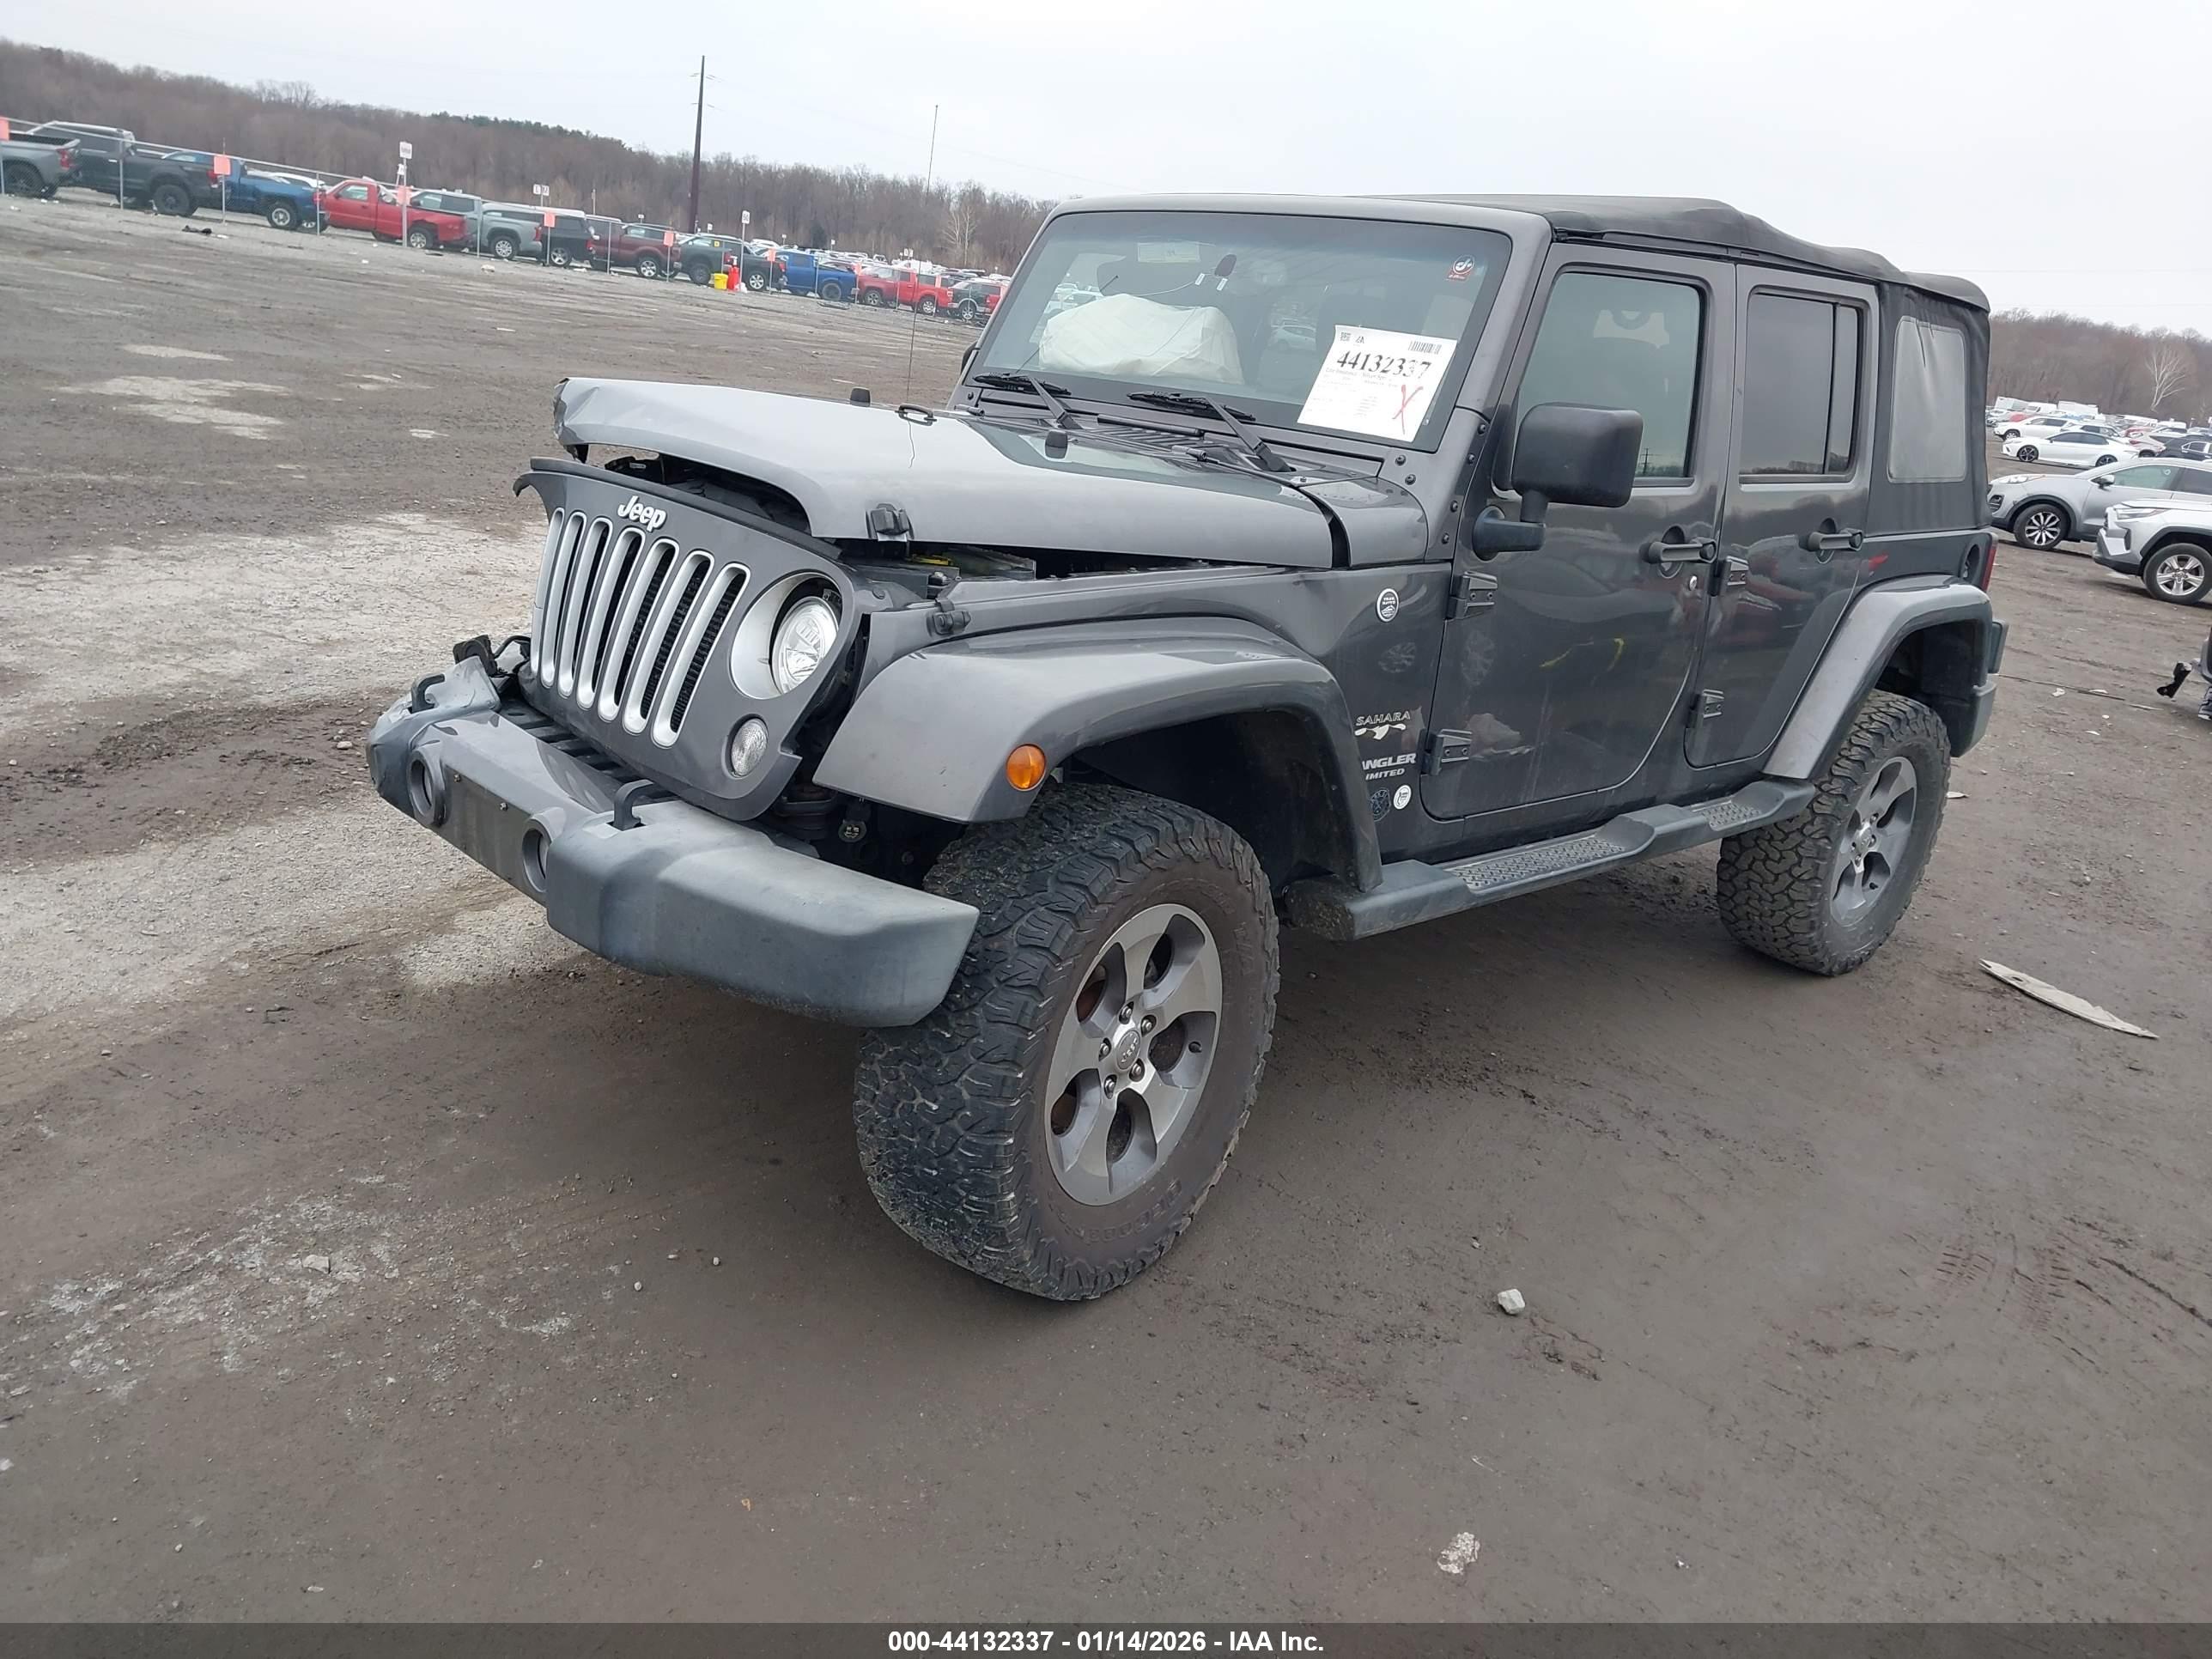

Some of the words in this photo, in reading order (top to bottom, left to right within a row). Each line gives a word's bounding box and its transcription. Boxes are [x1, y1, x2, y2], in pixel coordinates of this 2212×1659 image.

[1337, 349, 1432, 379] 44132337
[617, 495, 667, 532] Jeep
[1356, 710, 1411, 726] SAHARA
